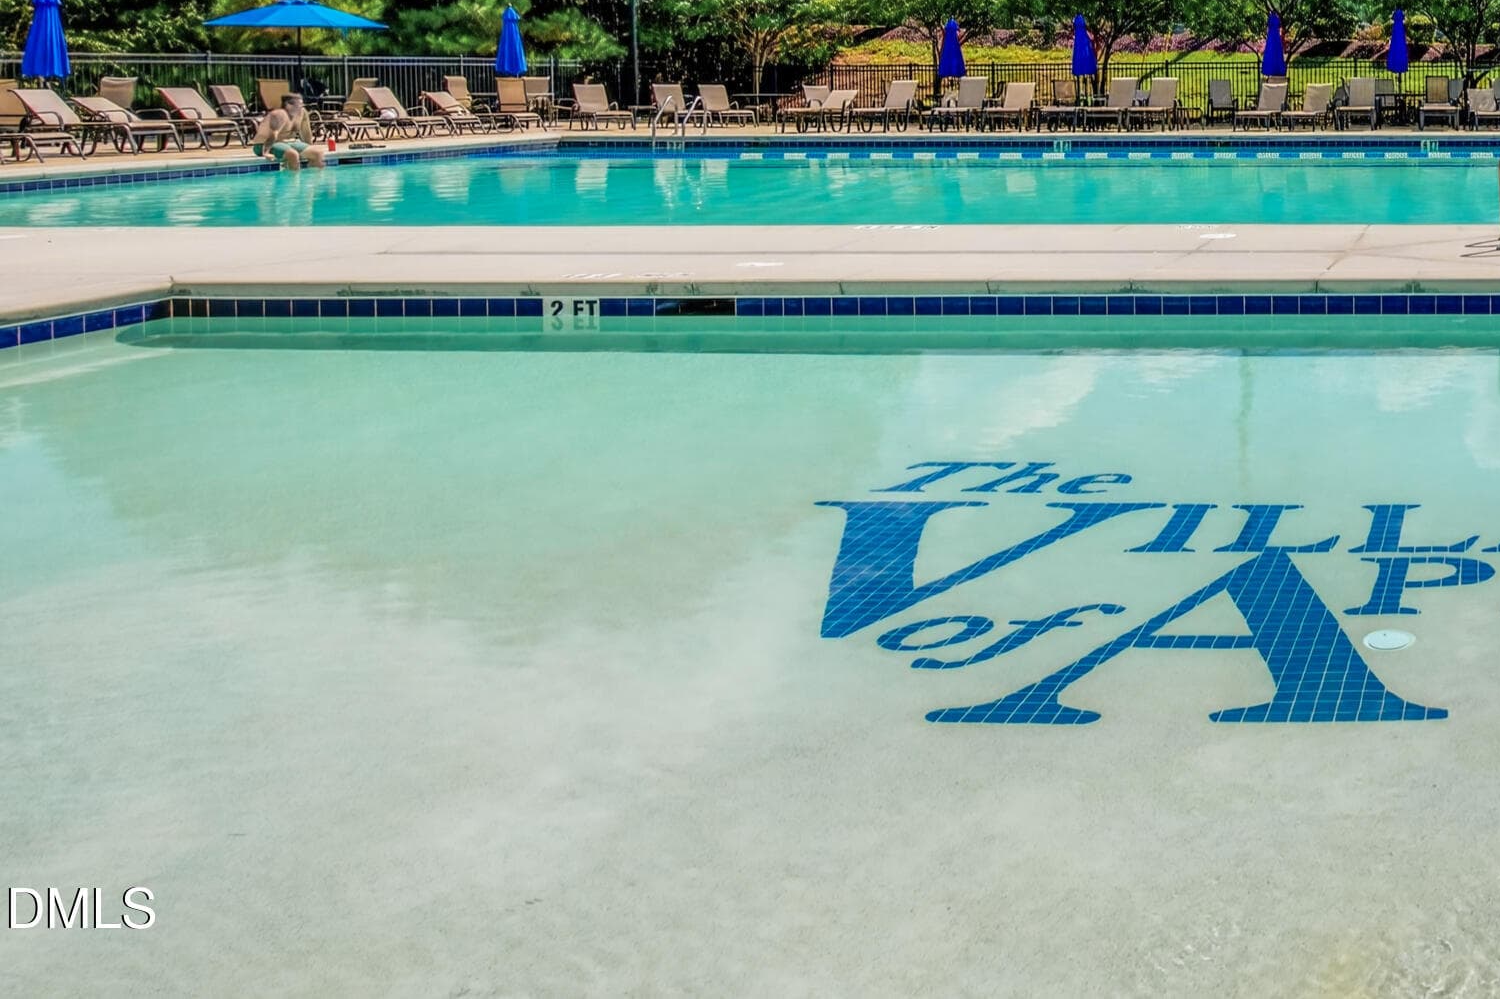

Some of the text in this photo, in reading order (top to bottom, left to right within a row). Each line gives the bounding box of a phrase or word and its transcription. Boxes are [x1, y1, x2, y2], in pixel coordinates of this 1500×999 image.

[550, 300, 598, 316] 2 FT
[869, 461, 1133, 494] The
[876, 603, 1126, 670] of
